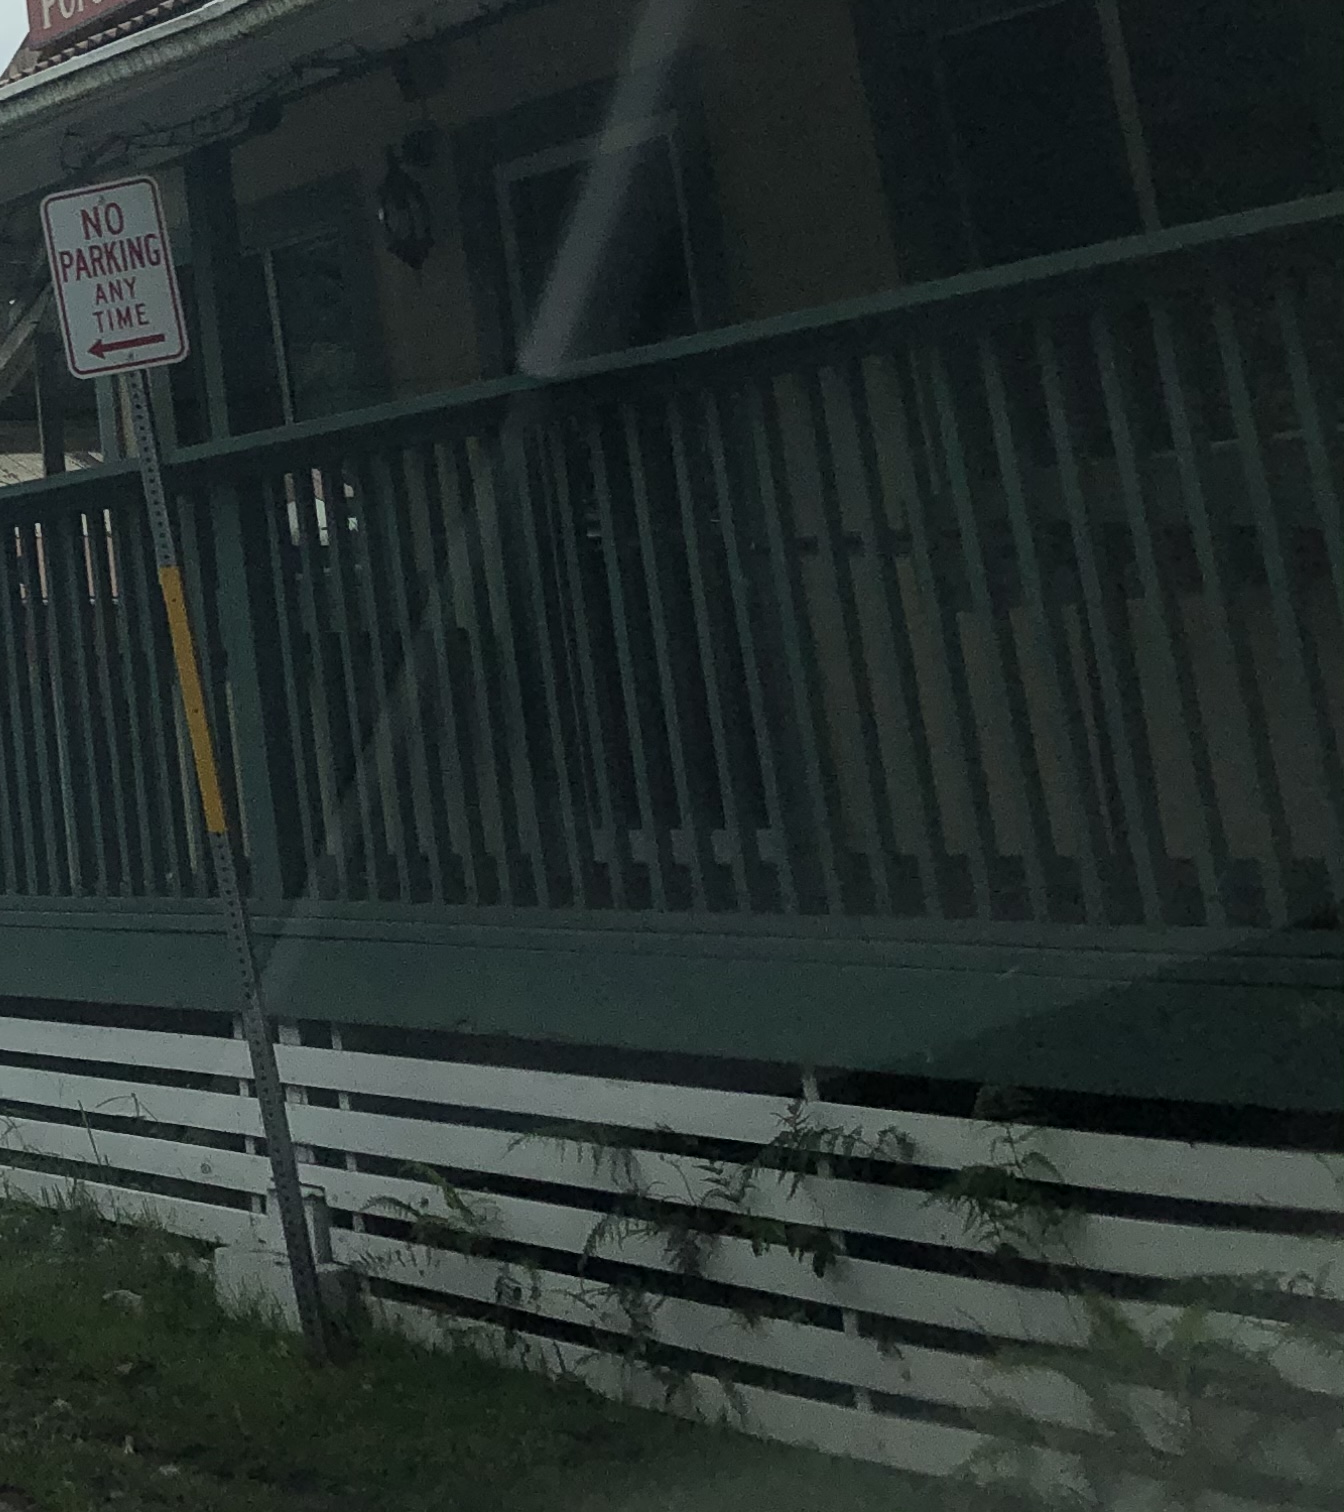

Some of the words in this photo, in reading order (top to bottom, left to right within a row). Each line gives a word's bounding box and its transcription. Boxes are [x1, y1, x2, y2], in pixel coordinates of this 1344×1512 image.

[80, 202, 125, 240] NO
[58, 233, 162, 283] PARKING
[95, 276, 137, 306] ANY
[92, 303, 150, 333] TIME
